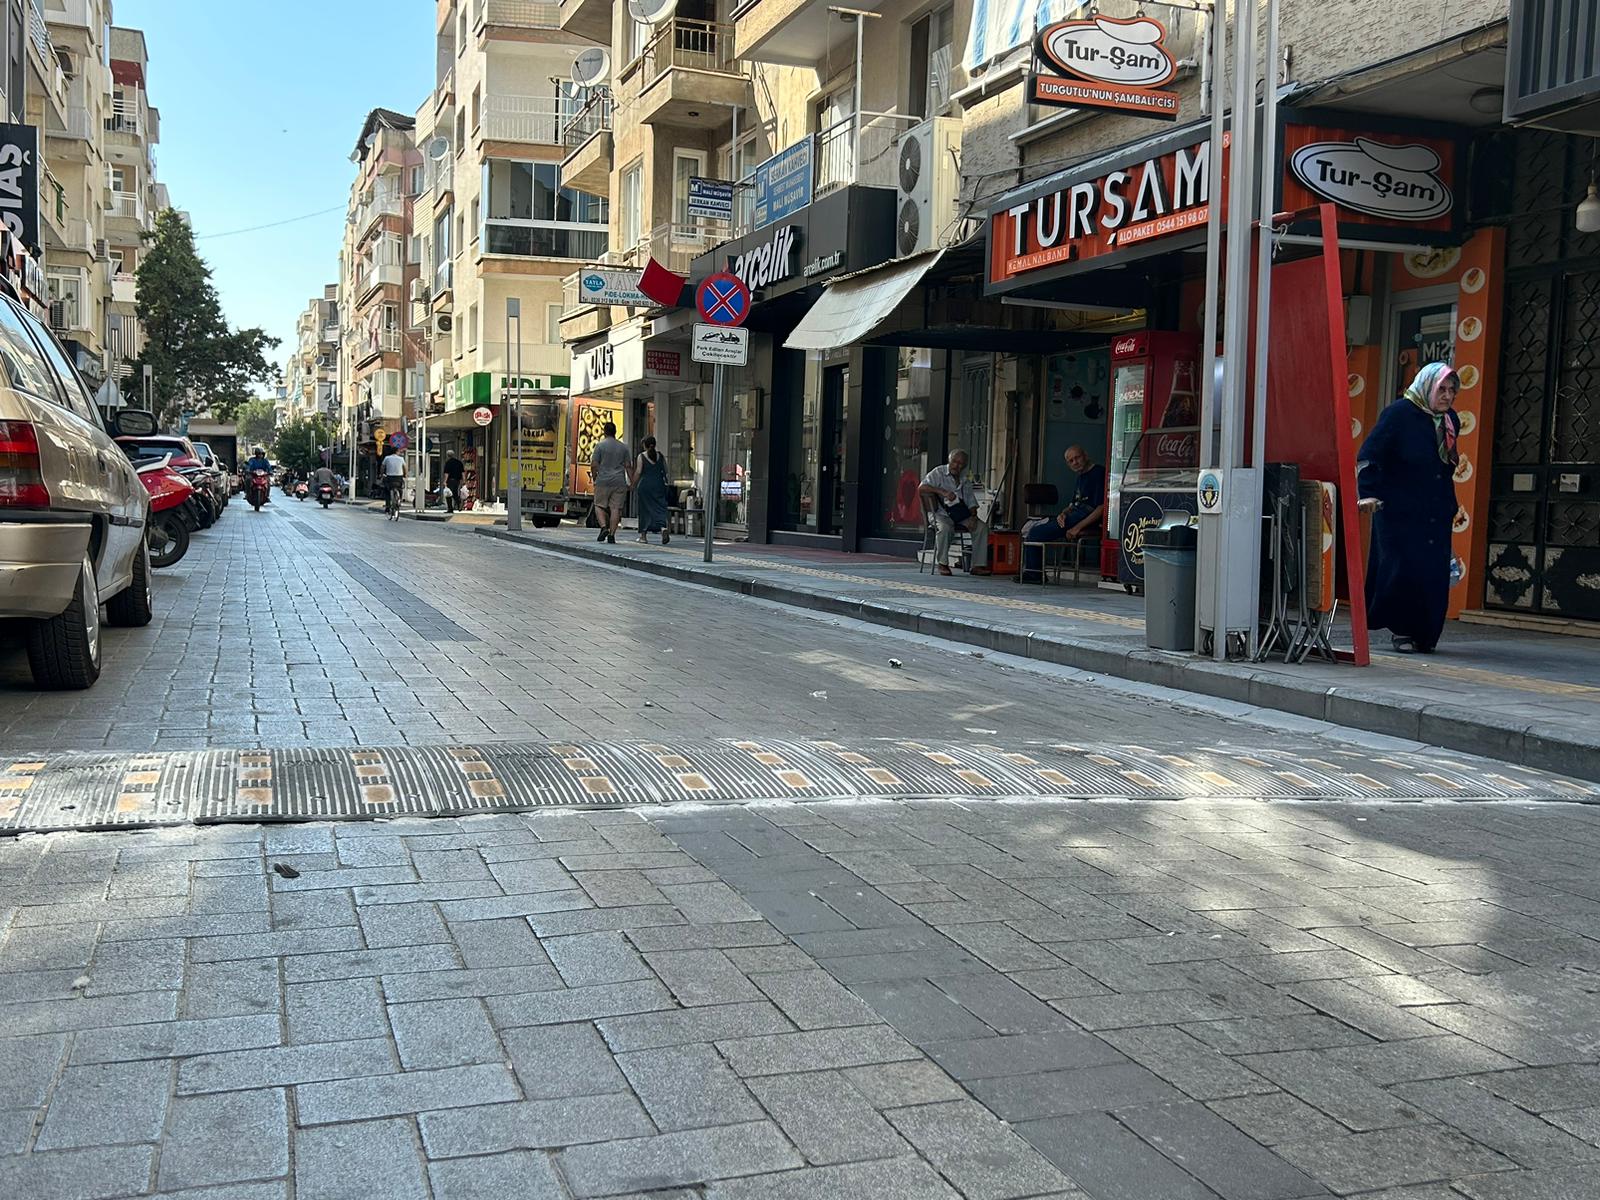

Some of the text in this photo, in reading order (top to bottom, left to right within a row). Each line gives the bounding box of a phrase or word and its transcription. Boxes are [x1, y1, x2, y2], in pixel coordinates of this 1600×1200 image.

[1064, 39, 1159, 70] Tur-Şam
[1040, 83, 1112, 99] TURGUTLU'NUN
[1316, 159, 1435, 202] Tur-Şam
[1009, 140, 1210, 256] TURŞAM
[1119, 230, 1132, 242] ALO
[1133, 223, 1154, 238] PAKET
[1156, 218, 1175, 233] 0544
[1198, 208, 1208, 221] 07
[1032, 248, 1067, 265] NALBANT
